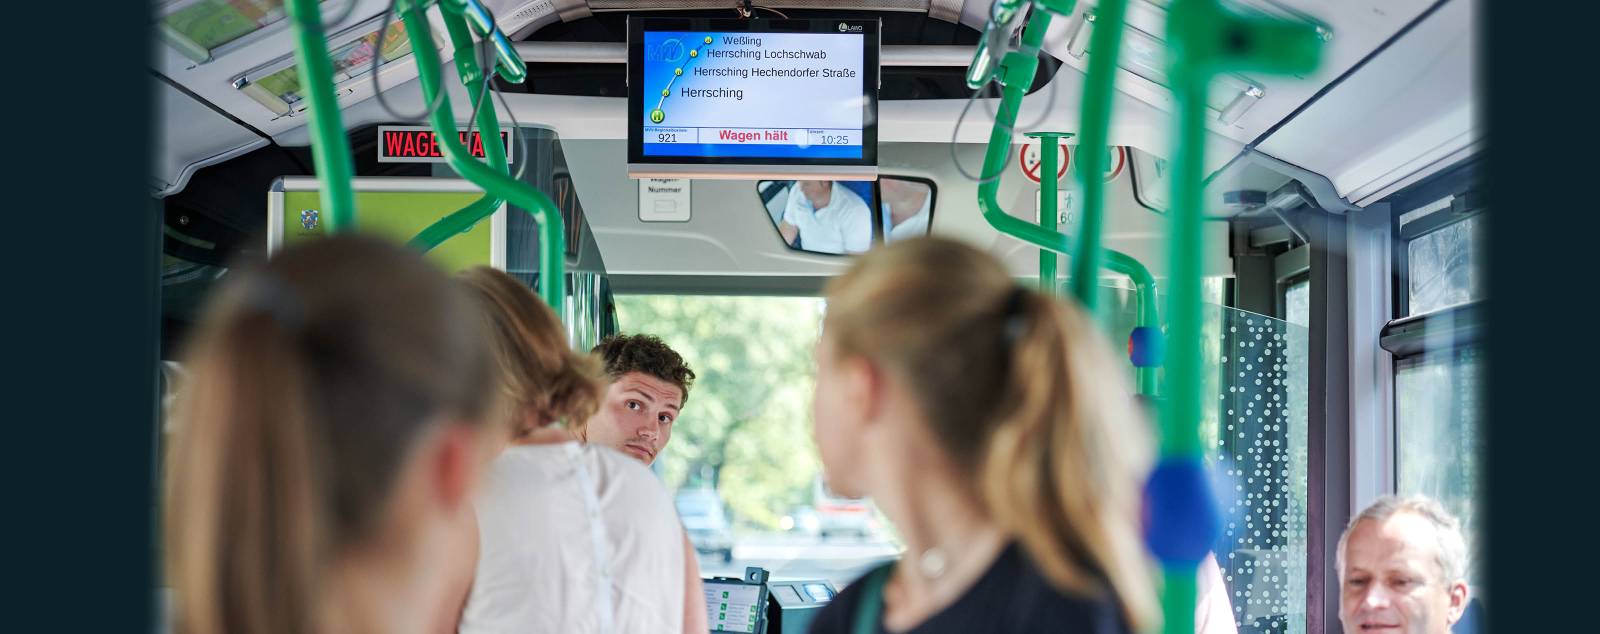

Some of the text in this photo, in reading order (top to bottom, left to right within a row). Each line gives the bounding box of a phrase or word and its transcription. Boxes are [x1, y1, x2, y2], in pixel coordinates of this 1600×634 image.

[723, 36, 762, 46] Weßling
[707, 49, 827, 60] Herrsching Lochschwab
[694, 67, 856, 79] Herrsching Hechendorfer Straße
[681, 87, 743, 100] Herrsching
[658, 133, 677, 143] 921
[719, 130, 788, 143] Wagen hält
[821, 135, 849, 145] 10:25
[386, 131, 446, 157] WAGE
